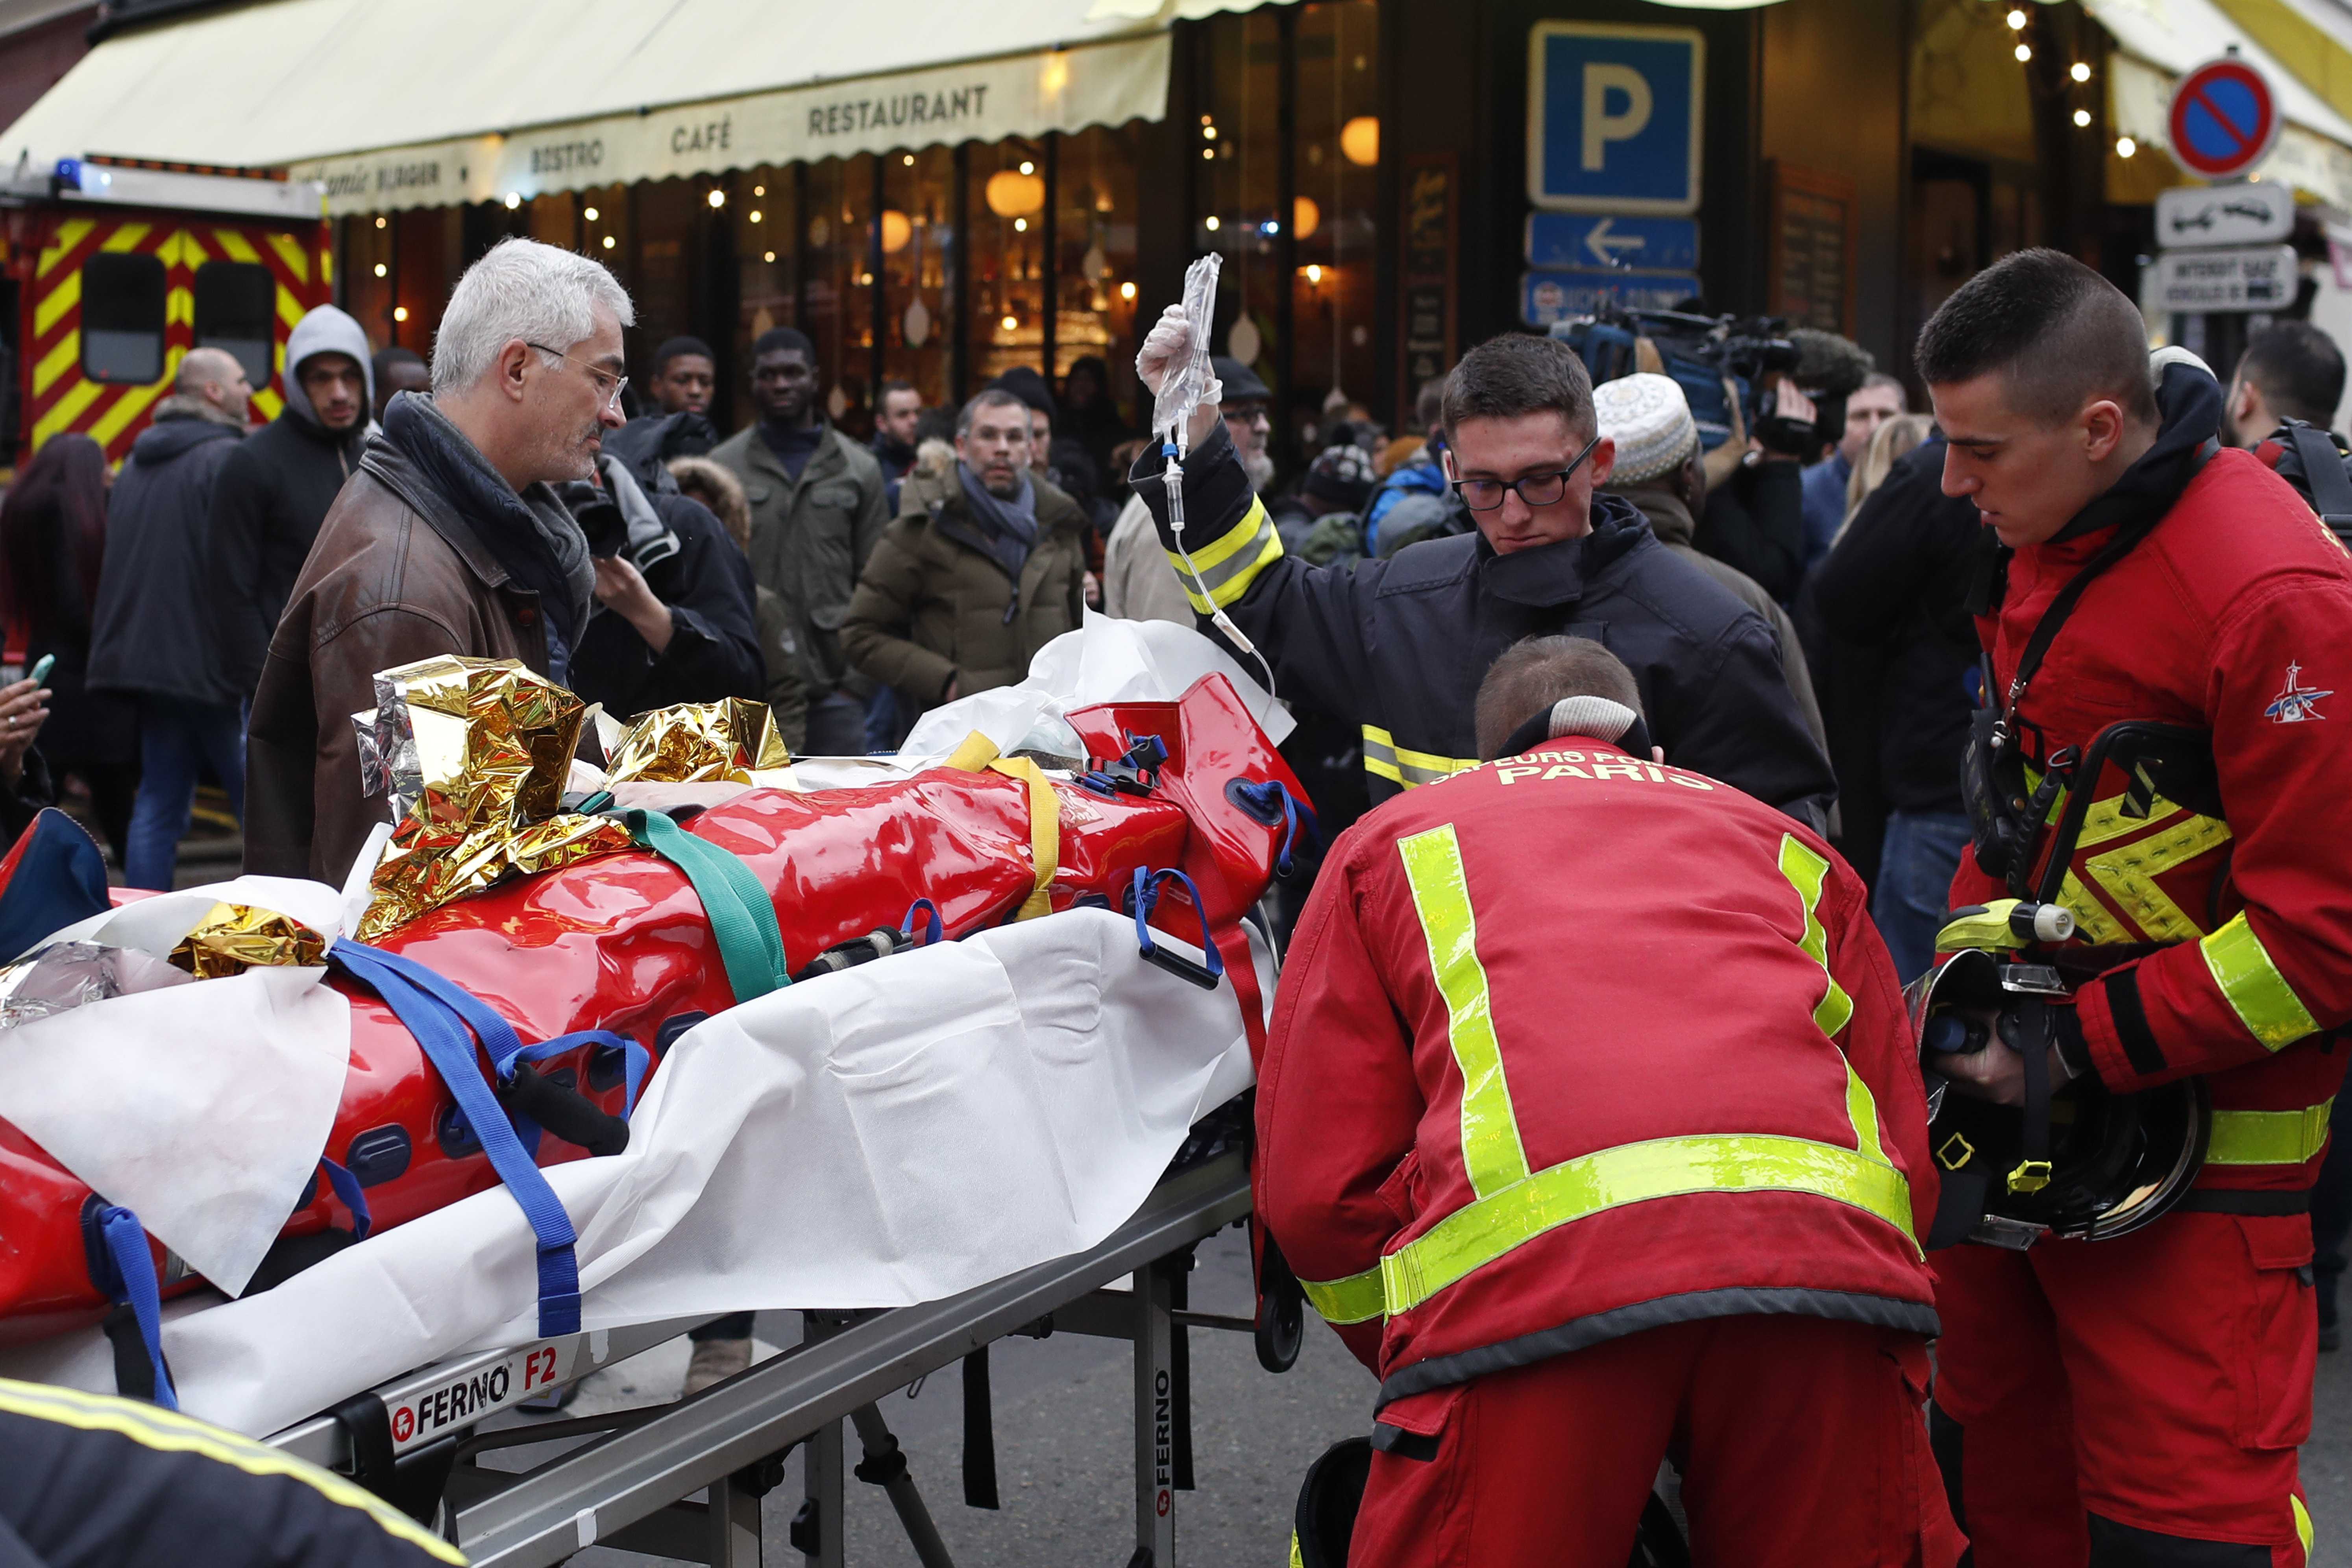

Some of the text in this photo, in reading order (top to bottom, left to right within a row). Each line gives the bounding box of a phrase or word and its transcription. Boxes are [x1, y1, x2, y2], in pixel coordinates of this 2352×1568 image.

[530, 137, 605, 174] BISTRO
[671, 112, 731, 154] CAFÉ
[808, 85, 988, 136] RESTAURANT
[1581, 63, 1653, 172] P
[1497, 764, 1714, 790] PARIS
[418, 1365, 510, 1435] FERNO
[525, 1346, 557, 1391] F2
[1155, 1370, 1170, 1486] FERNO
